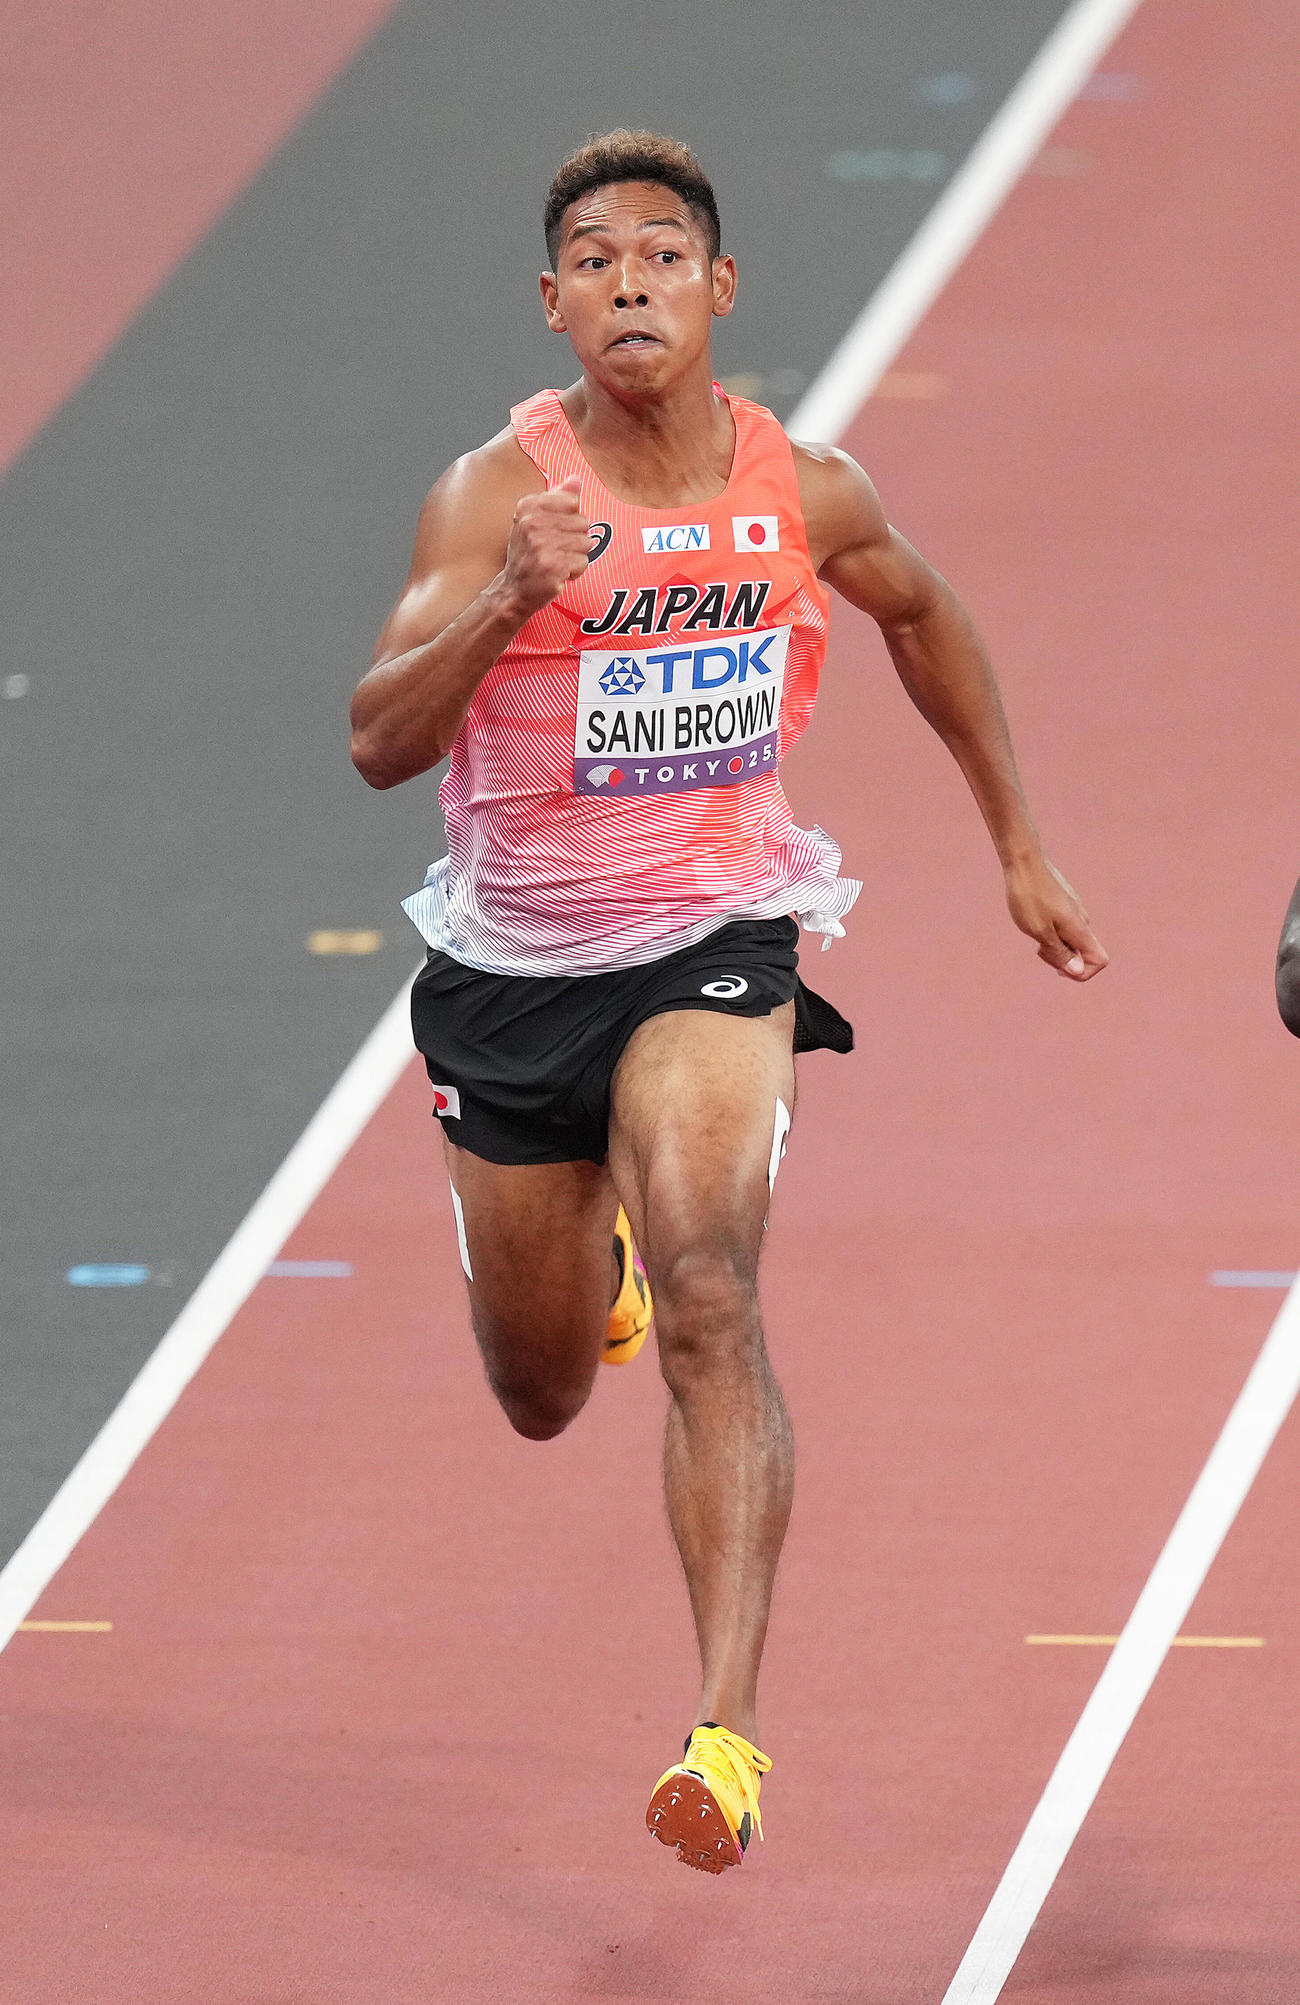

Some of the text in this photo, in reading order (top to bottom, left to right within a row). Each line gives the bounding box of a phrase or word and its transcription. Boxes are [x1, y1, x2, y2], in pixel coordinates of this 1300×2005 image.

[647, 526, 706, 551] ACN
[581, 581, 772, 635] JAPAN
[646, 635, 777, 694] TDK
[586, 686, 776, 753] SANI BROWN
